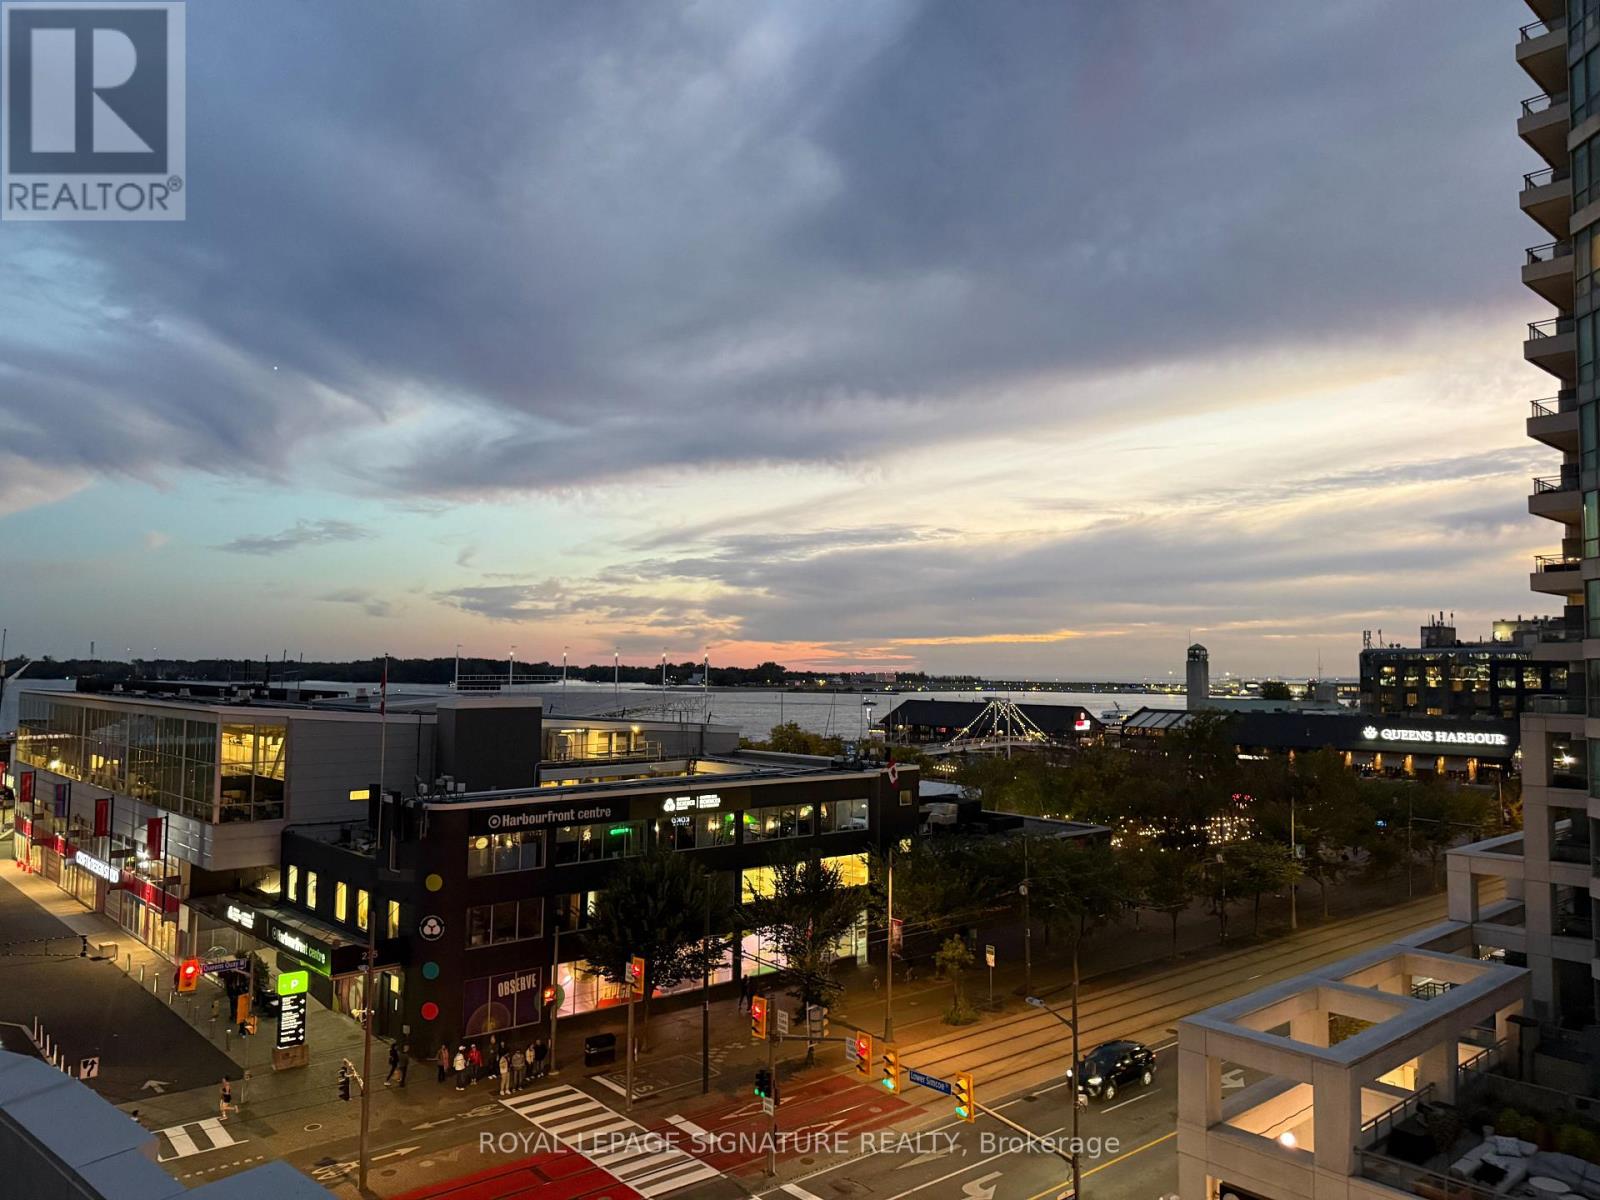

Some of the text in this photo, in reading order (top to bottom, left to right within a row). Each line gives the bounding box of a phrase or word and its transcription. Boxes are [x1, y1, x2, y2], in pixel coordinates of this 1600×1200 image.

[1380, 728, 1507, 745] QUEENS HARBOUR
[502, 806, 612, 827] Harbourfront centre
[361, 950, 378, 960] 25
[497, 973, 537, 998] OBSERVE
